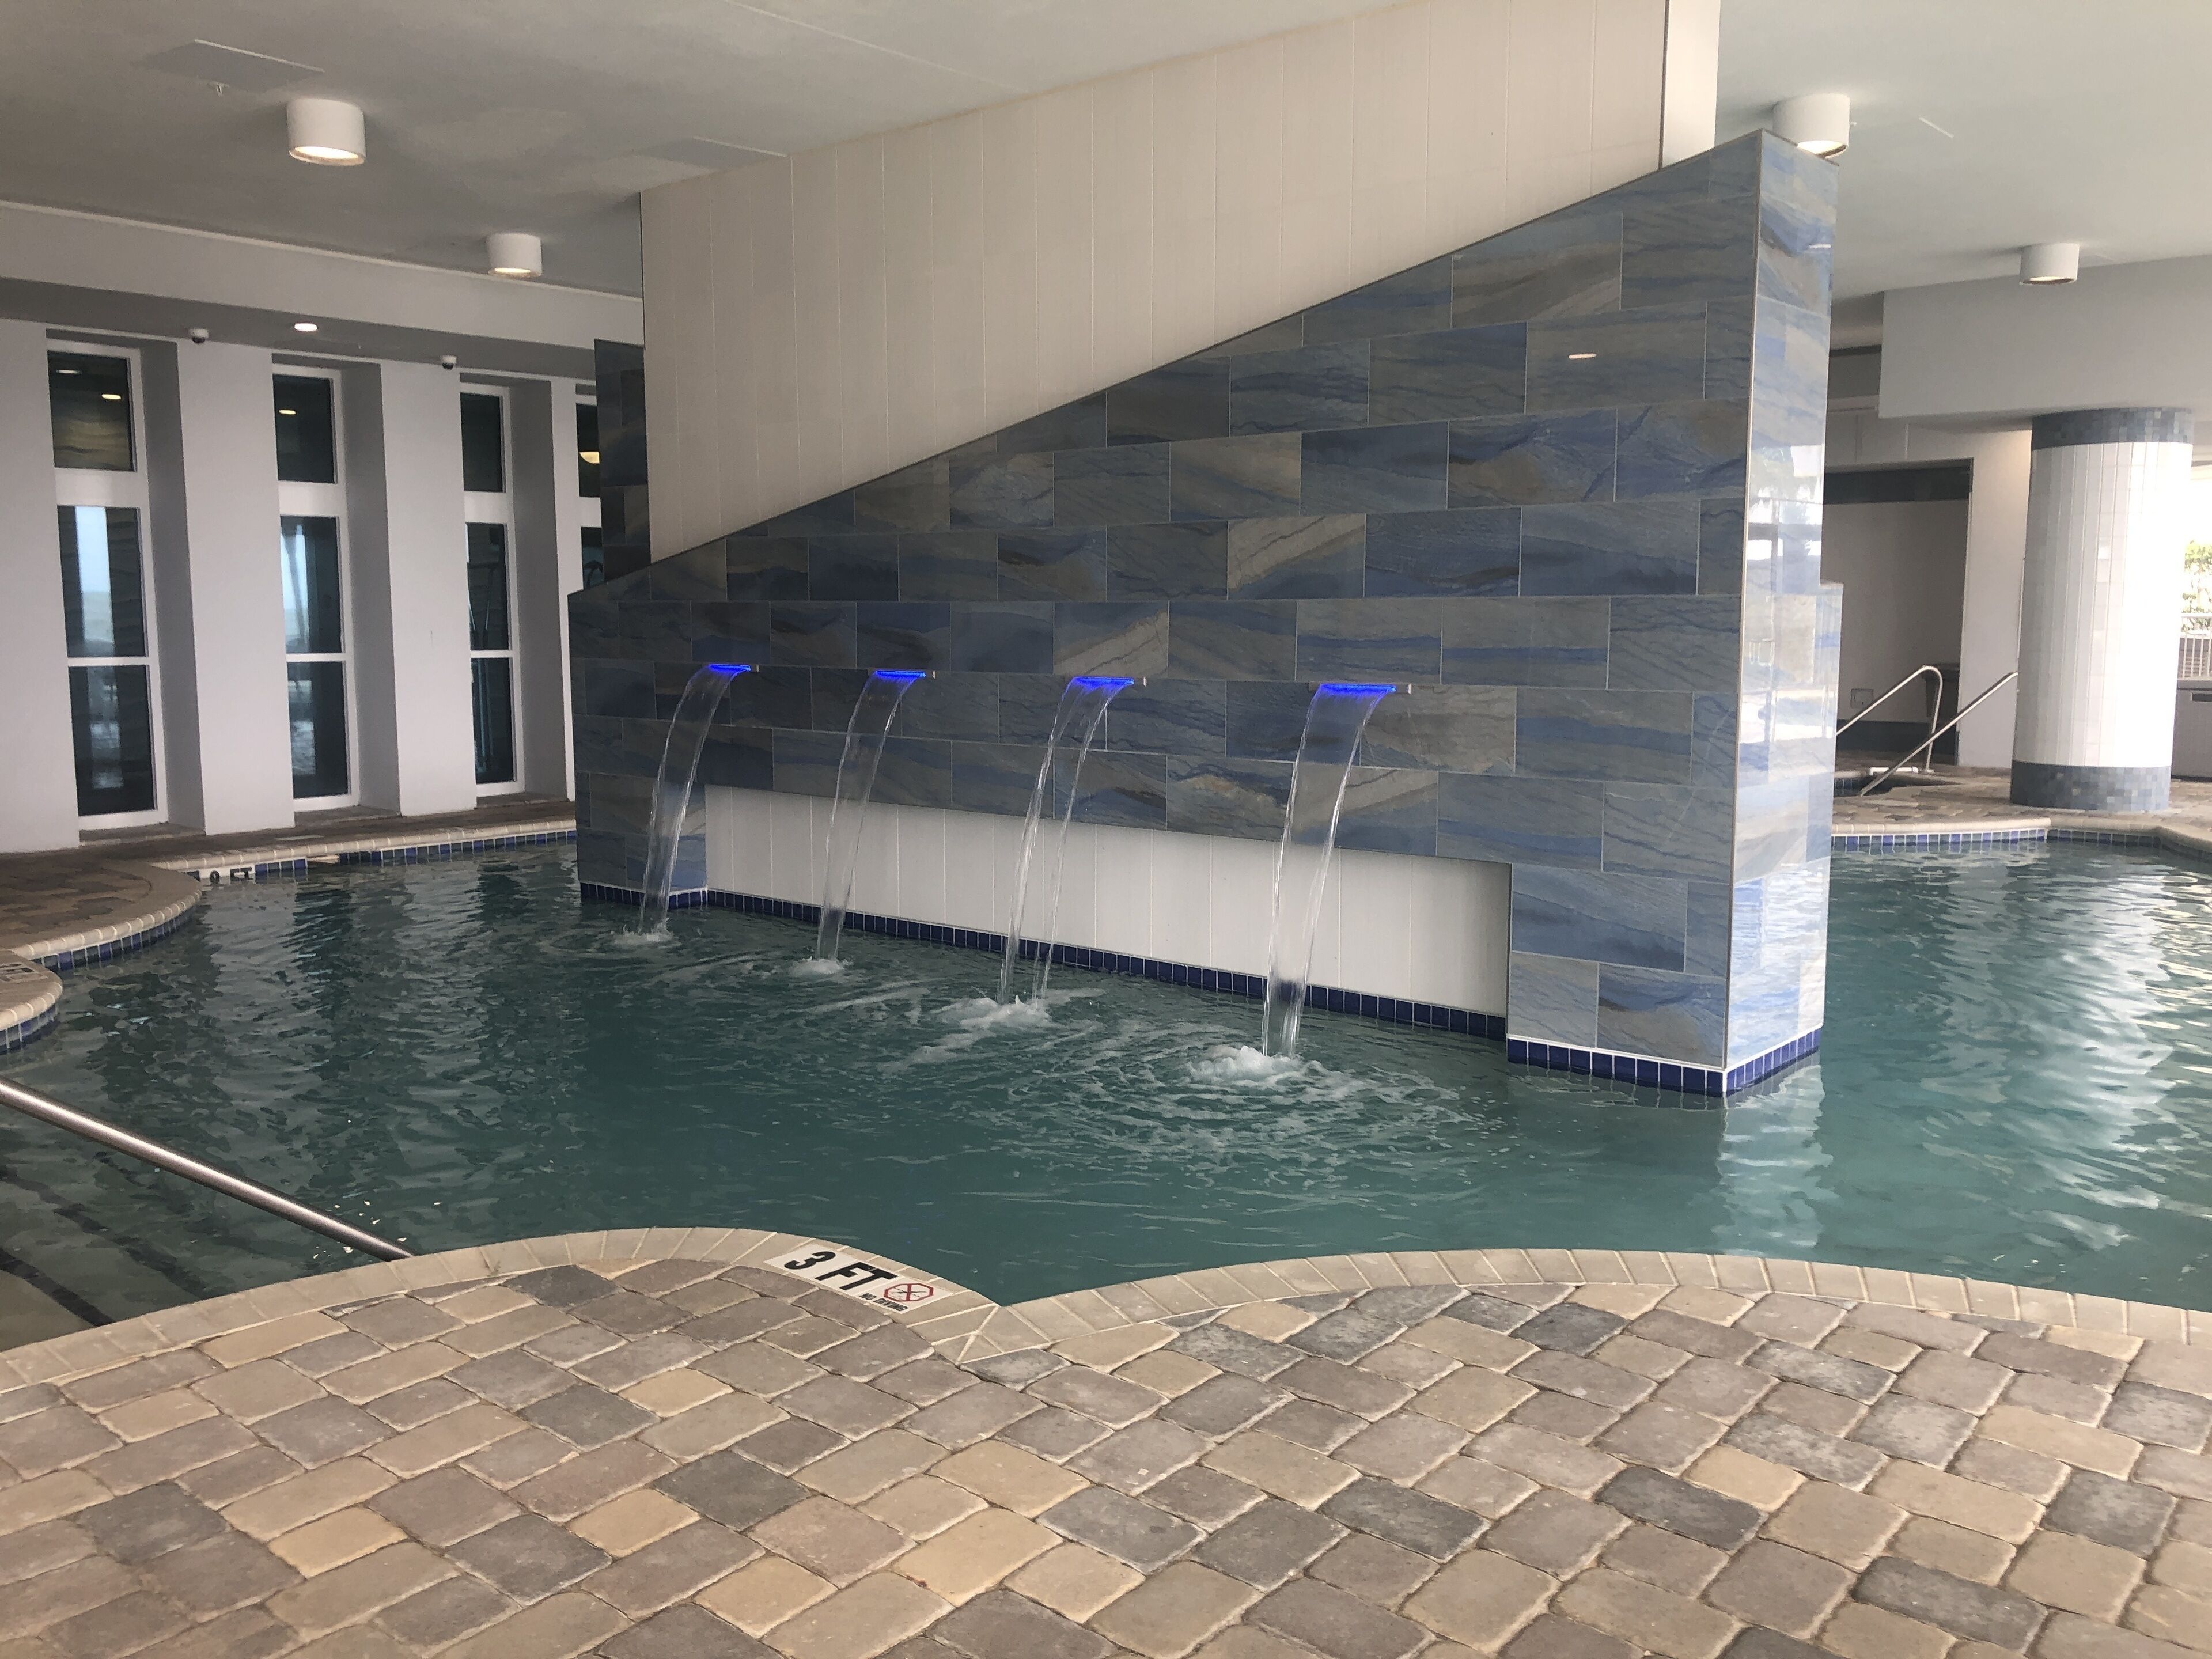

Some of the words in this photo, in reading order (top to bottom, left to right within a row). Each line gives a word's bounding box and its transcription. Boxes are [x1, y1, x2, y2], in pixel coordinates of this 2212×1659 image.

[784, 1251, 836, 1270] 3
[815, 1262, 899, 1291] FT
[873, 1298, 908, 1312] DIVING
